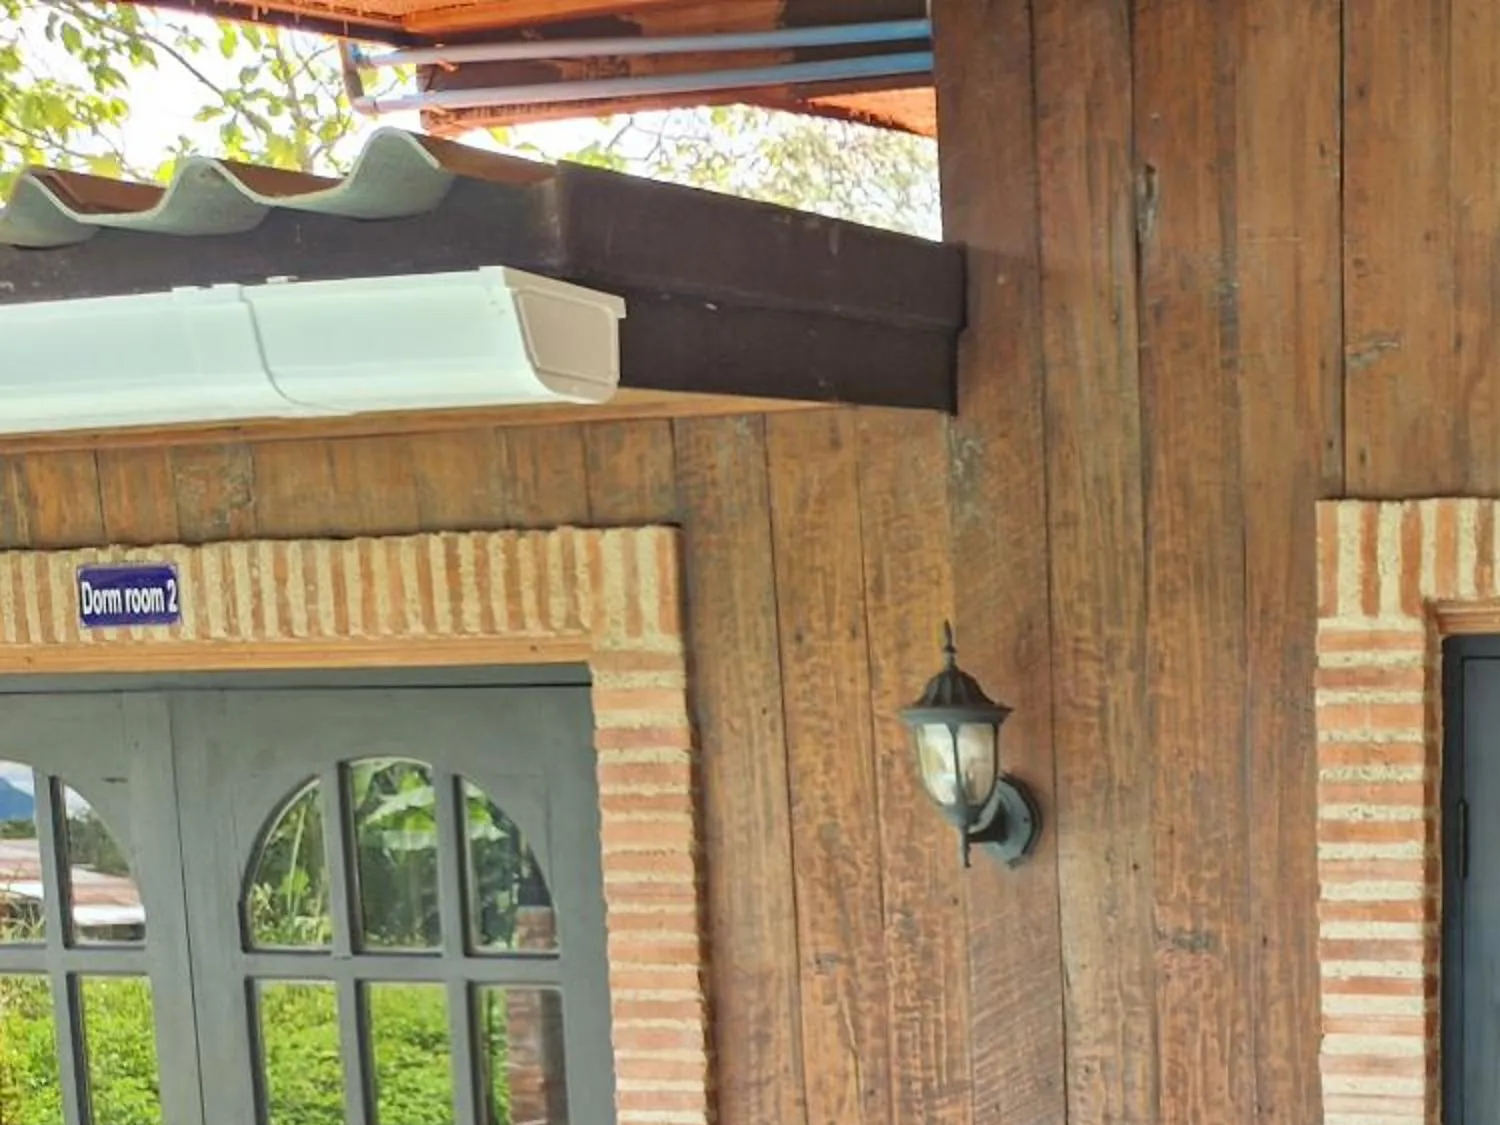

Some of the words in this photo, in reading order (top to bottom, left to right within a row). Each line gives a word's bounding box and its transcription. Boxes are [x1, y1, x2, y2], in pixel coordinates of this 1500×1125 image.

[81, 581, 122, 615] Dorm
[125, 587, 165, 614] room
[167, 579, 178, 613] 2
